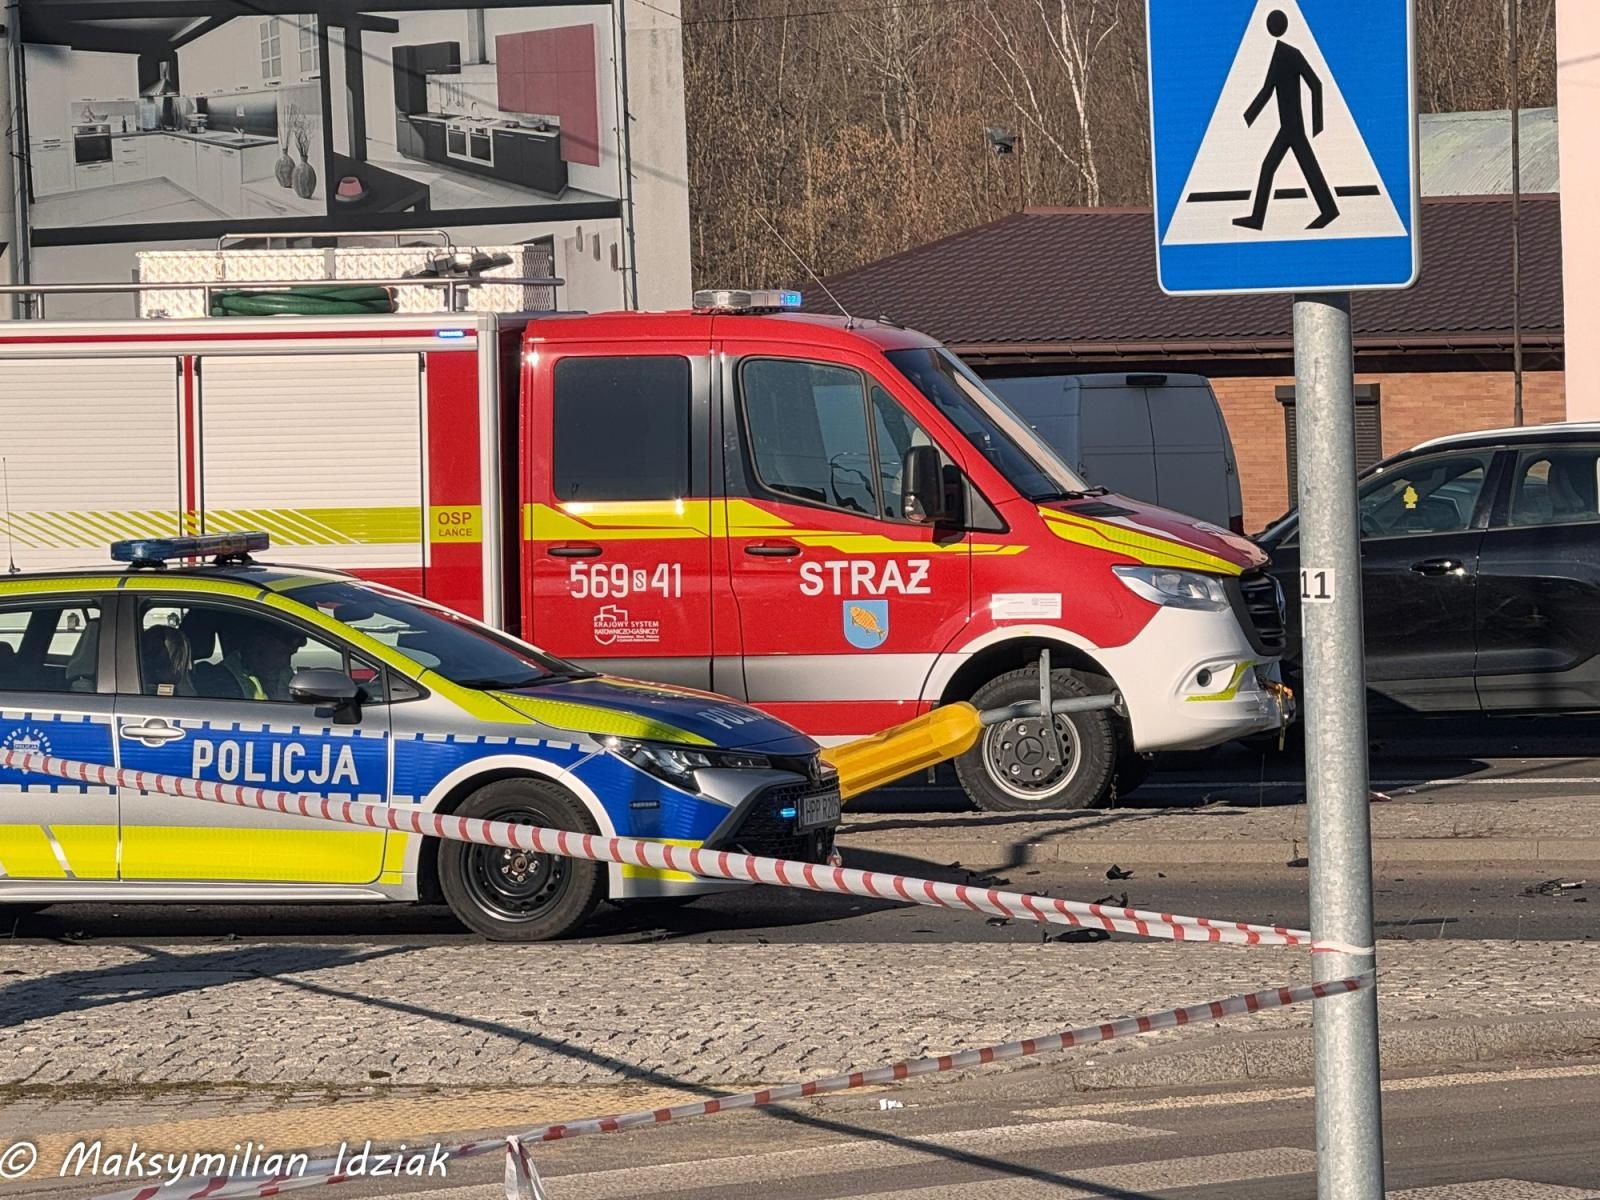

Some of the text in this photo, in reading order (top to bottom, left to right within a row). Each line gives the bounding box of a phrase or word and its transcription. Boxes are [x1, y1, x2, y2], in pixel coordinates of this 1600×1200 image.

[438, 512, 472, 525] OSP
[1301, 570, 1332, 599] 11
[593, 620, 660, 628] KRAJOWY SYSTEM
[191, 739, 360, 786] POLICJA
